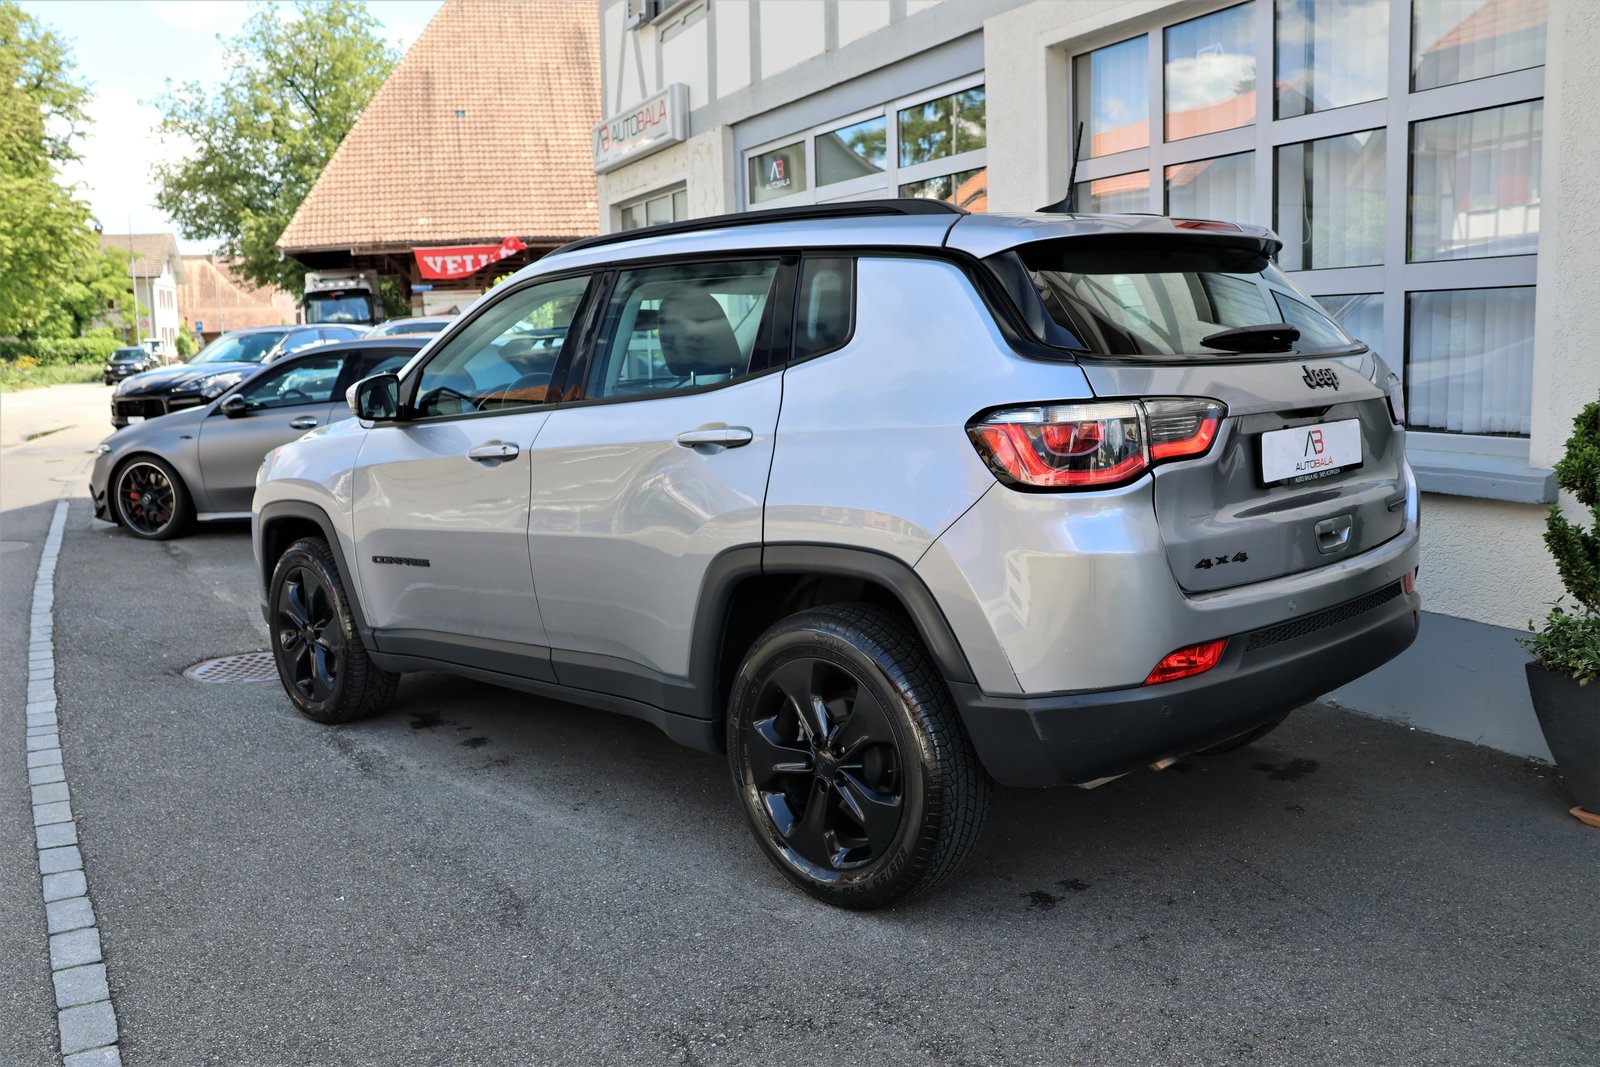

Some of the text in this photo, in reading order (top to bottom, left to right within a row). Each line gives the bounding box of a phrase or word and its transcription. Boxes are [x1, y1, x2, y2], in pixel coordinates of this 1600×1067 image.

[612, 99, 667, 143] AUTOBALA
[1301, 364, 1340, 391] Jeep
[1295, 456, 1333, 471] AUTOBALA
